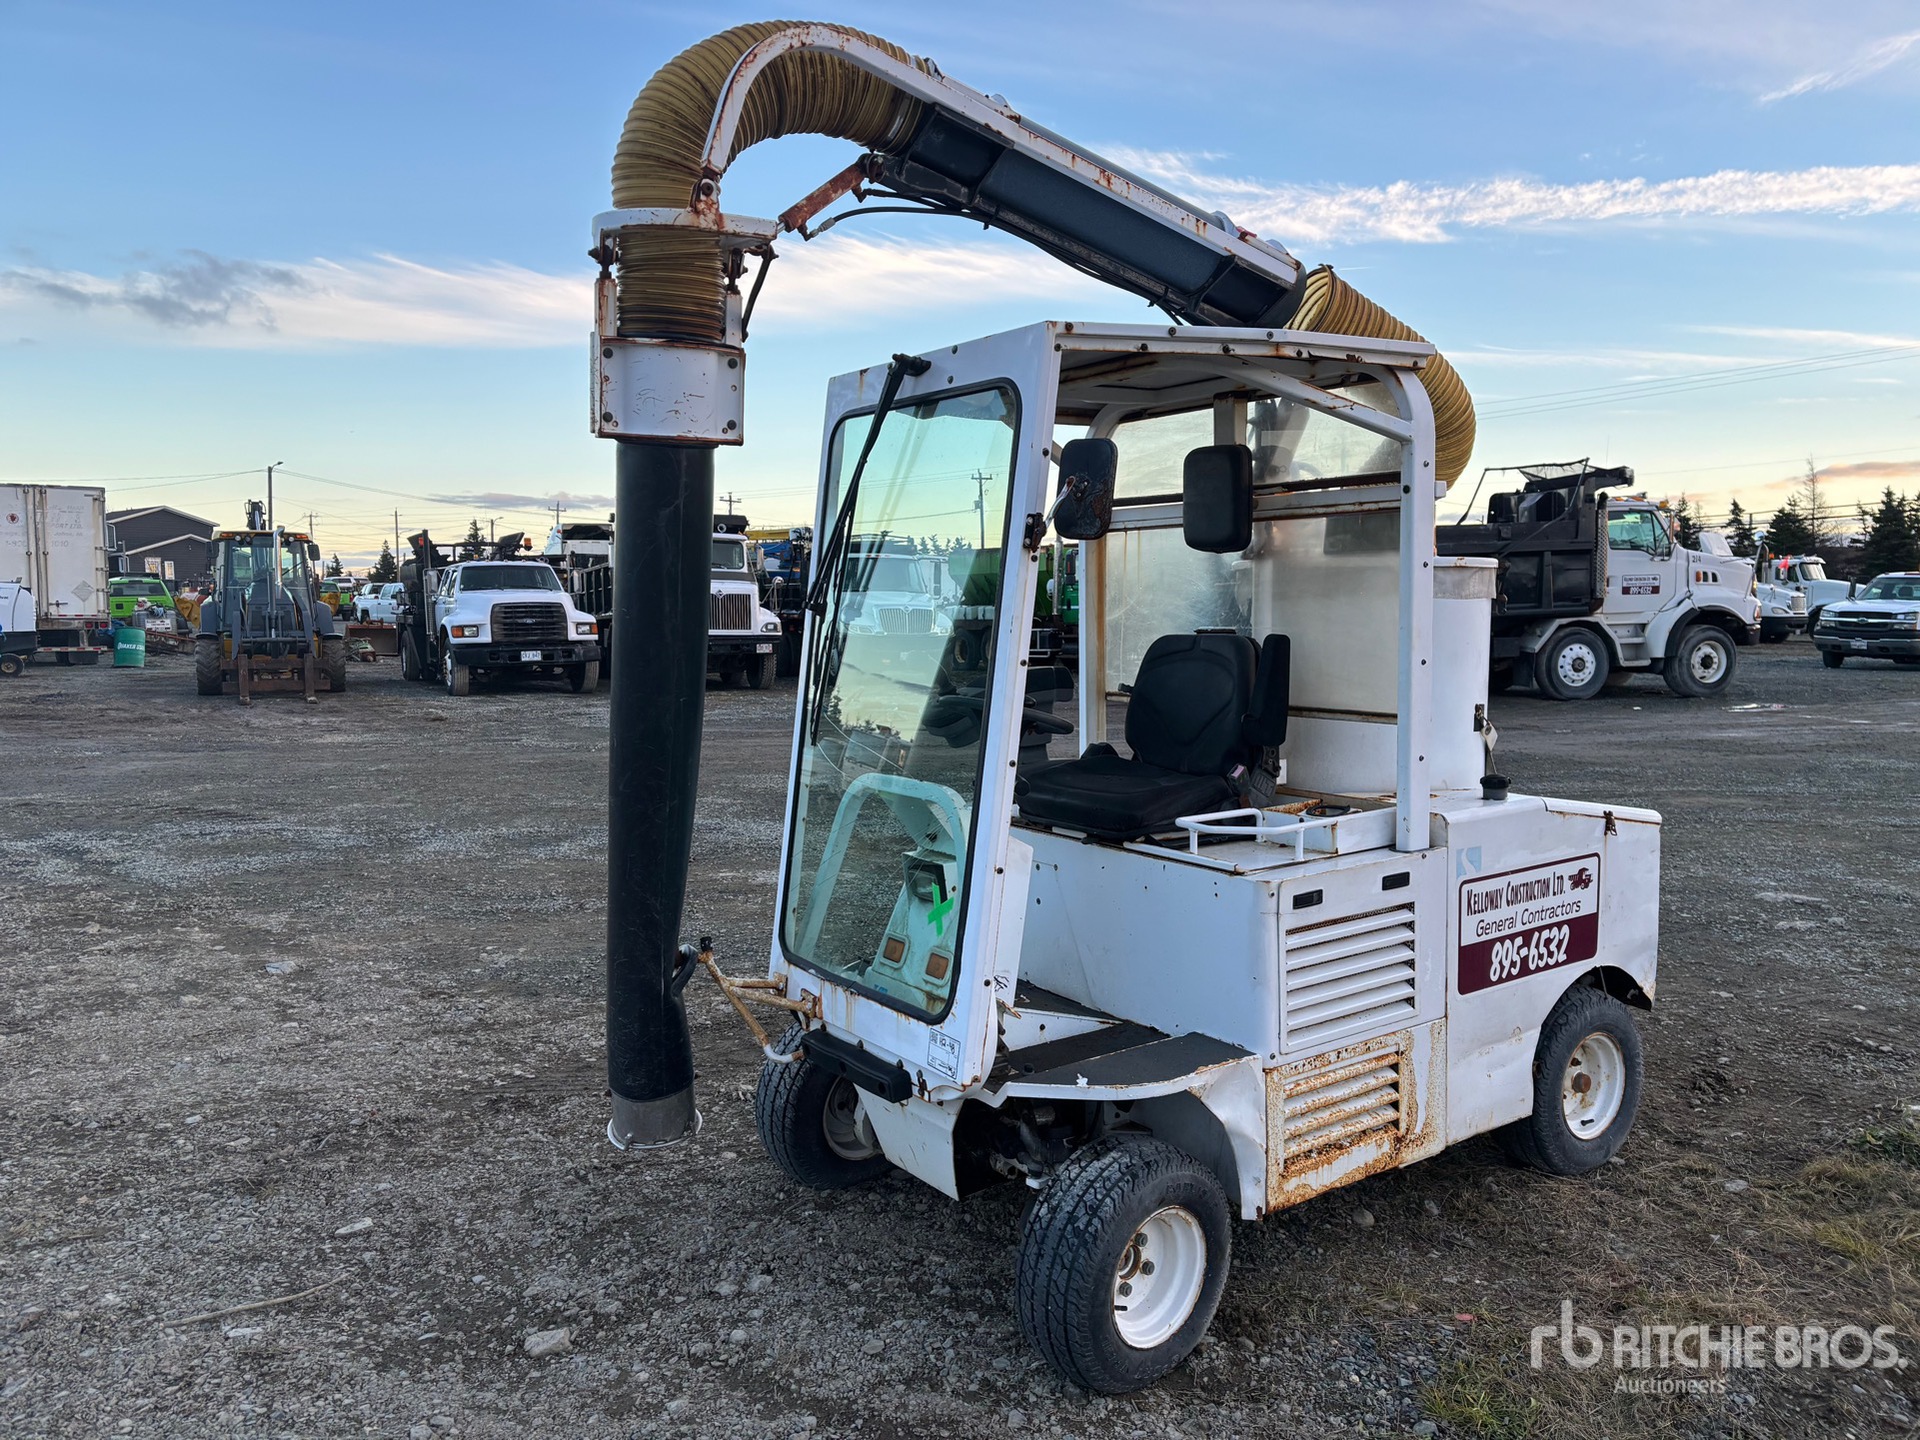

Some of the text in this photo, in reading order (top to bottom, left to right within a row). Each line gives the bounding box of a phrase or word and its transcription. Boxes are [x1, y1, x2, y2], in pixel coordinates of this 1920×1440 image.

[1467, 887, 1504, 916] KELLOWAY
[1506, 877, 1551, 907] CONSTRUCTION
[1476, 899, 1582, 938] General Contractors
[1489, 924, 1570, 982] 895-6532
